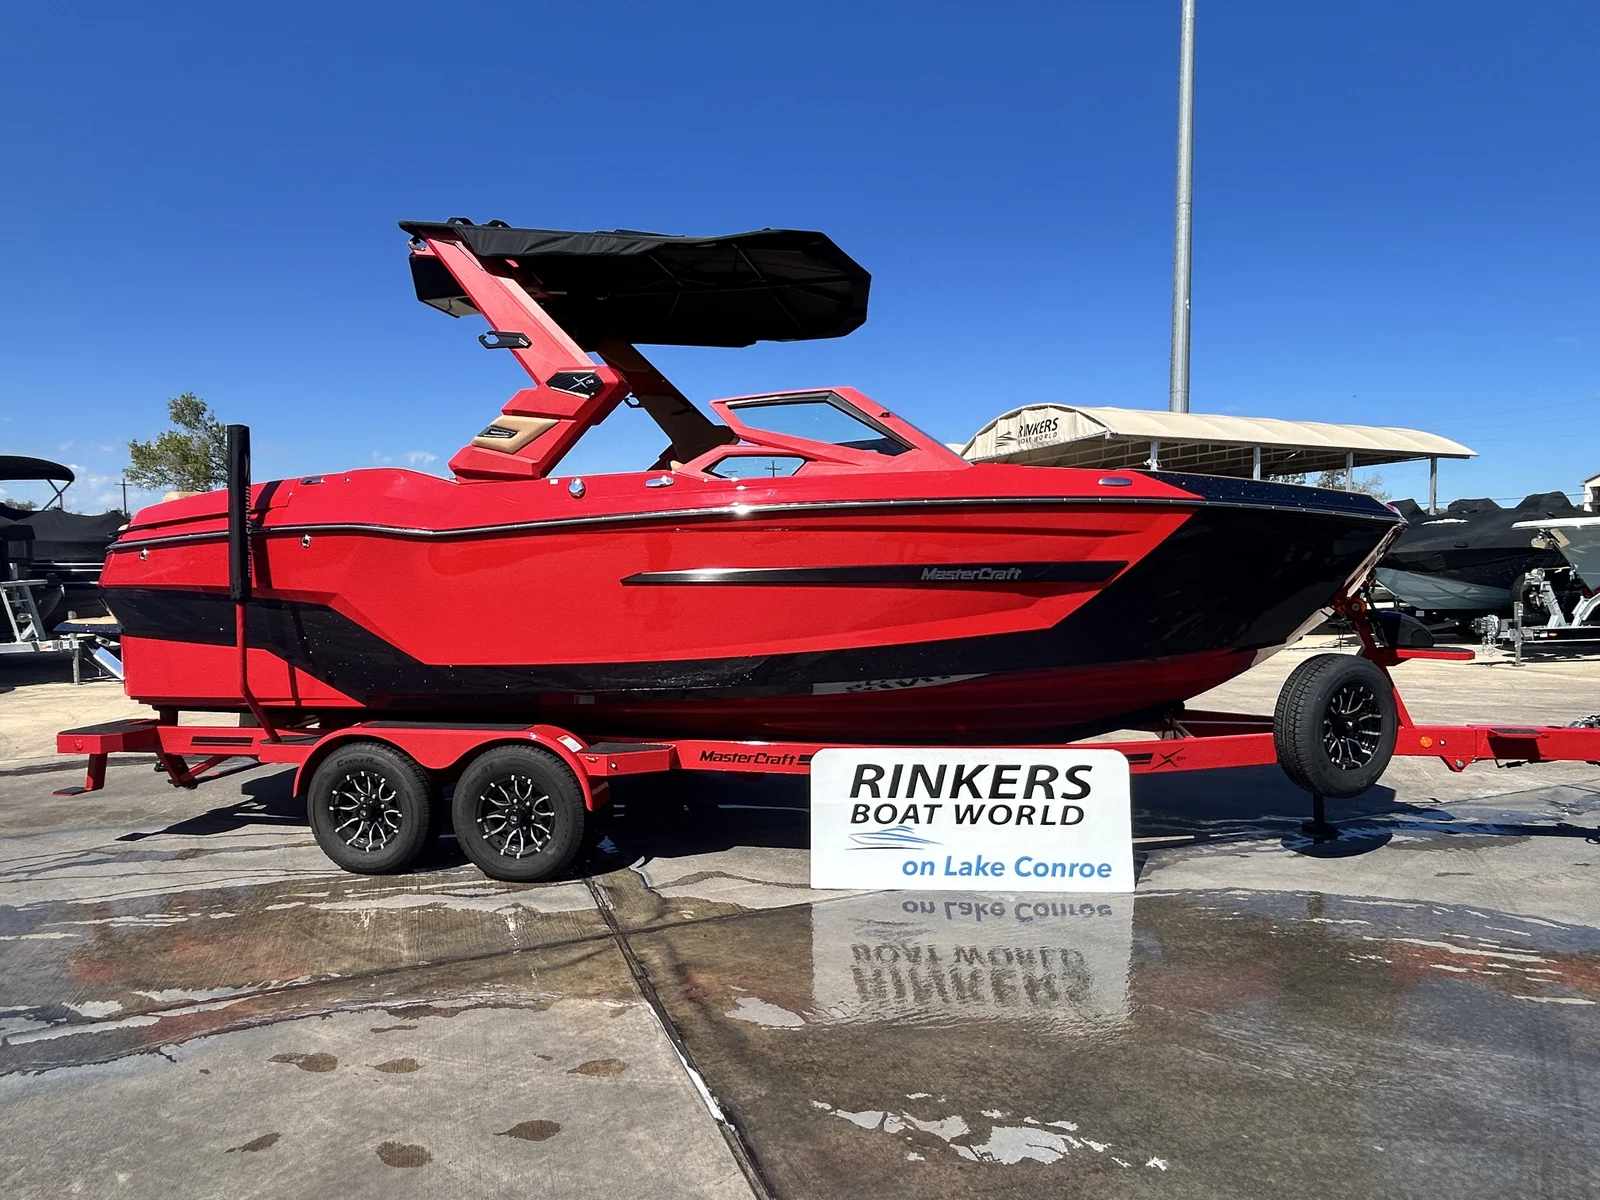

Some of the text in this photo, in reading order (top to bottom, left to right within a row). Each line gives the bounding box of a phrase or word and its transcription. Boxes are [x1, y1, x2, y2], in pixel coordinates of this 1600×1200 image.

[1018, 417, 1059, 438] RINKERS
[920, 567, 1022, 581] MasterCraft
[699, 750, 797, 766] MasterCraft
[850, 763, 1093, 800] RINKERS
[850, 803, 1085, 826] BOAT WORLD
[902, 855, 1113, 878] on Lake Conroe
